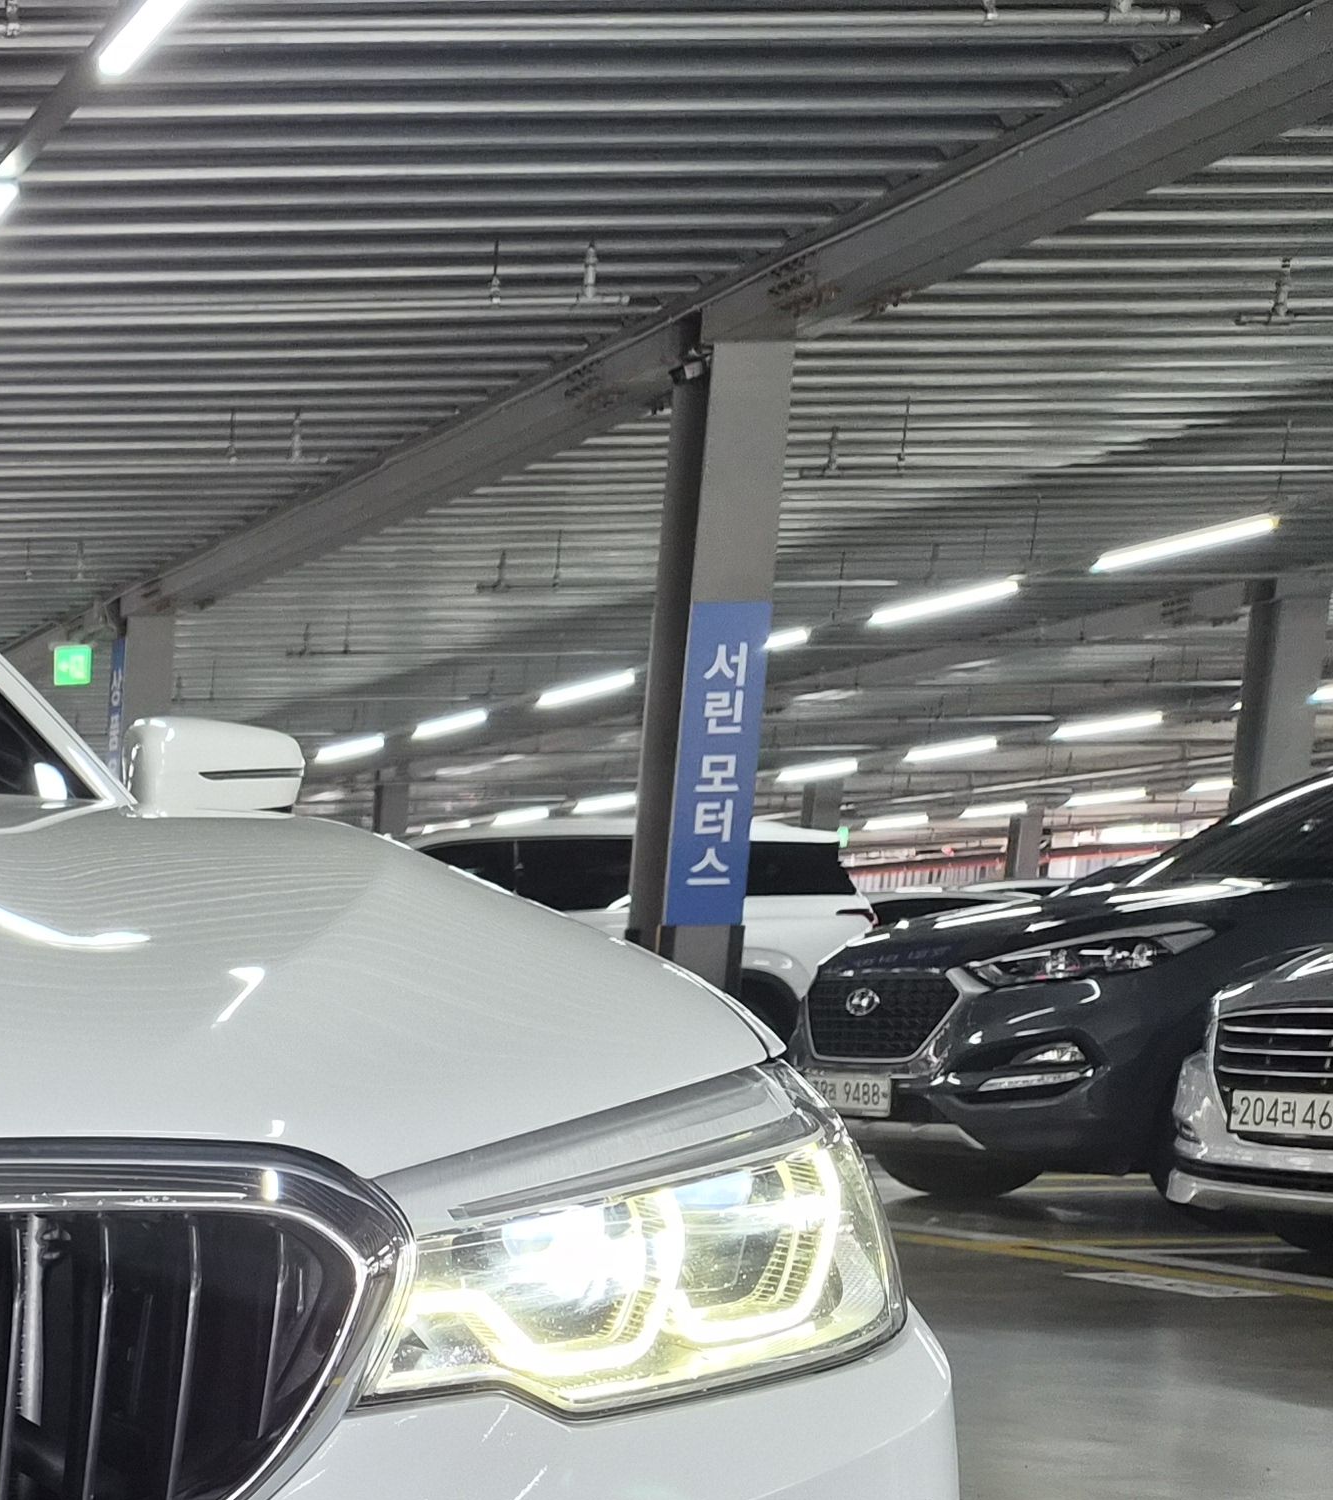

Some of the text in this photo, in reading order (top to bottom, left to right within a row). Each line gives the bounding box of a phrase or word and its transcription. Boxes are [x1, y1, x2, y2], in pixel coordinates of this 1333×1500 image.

[686, 641, 749, 886] 서린 모터스
[843, 1081, 881, 1106] 9488
[1301, 1099, 1333, 1130] 46
